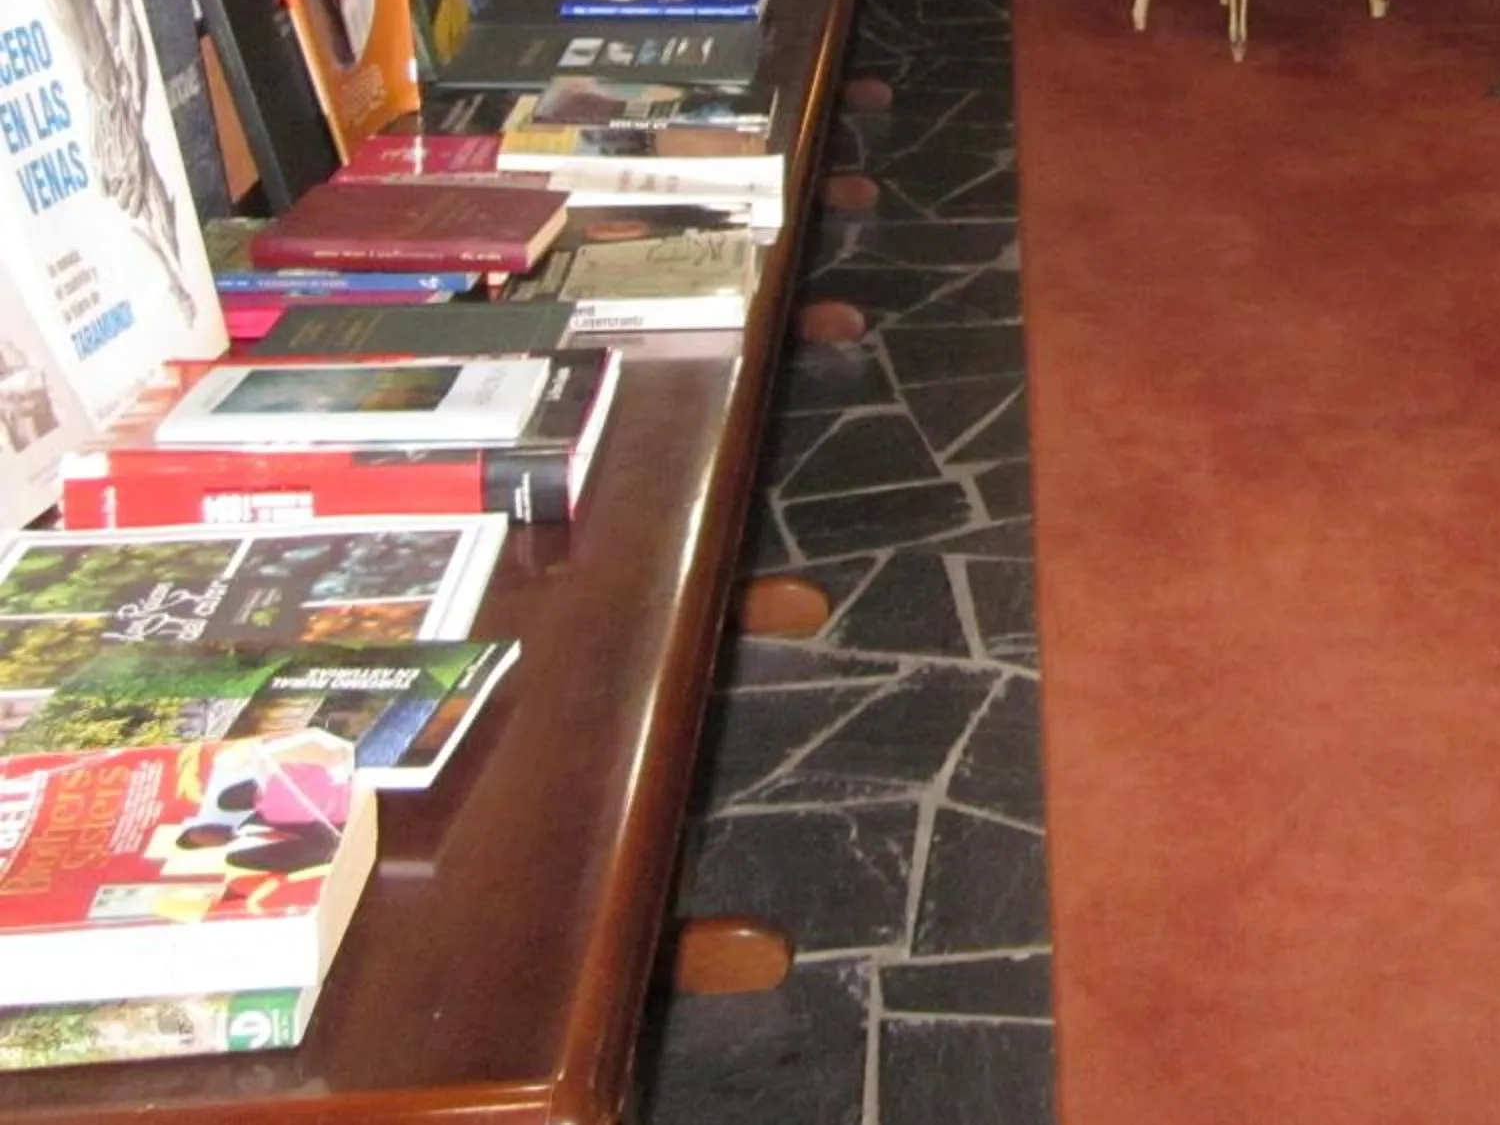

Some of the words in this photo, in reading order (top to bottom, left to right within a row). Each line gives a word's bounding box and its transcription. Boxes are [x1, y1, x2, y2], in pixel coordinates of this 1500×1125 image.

[0, 93, 32, 155] EN
[26, 79, 71, 139] LAS
[17, 140, 88, 215] VENAS
